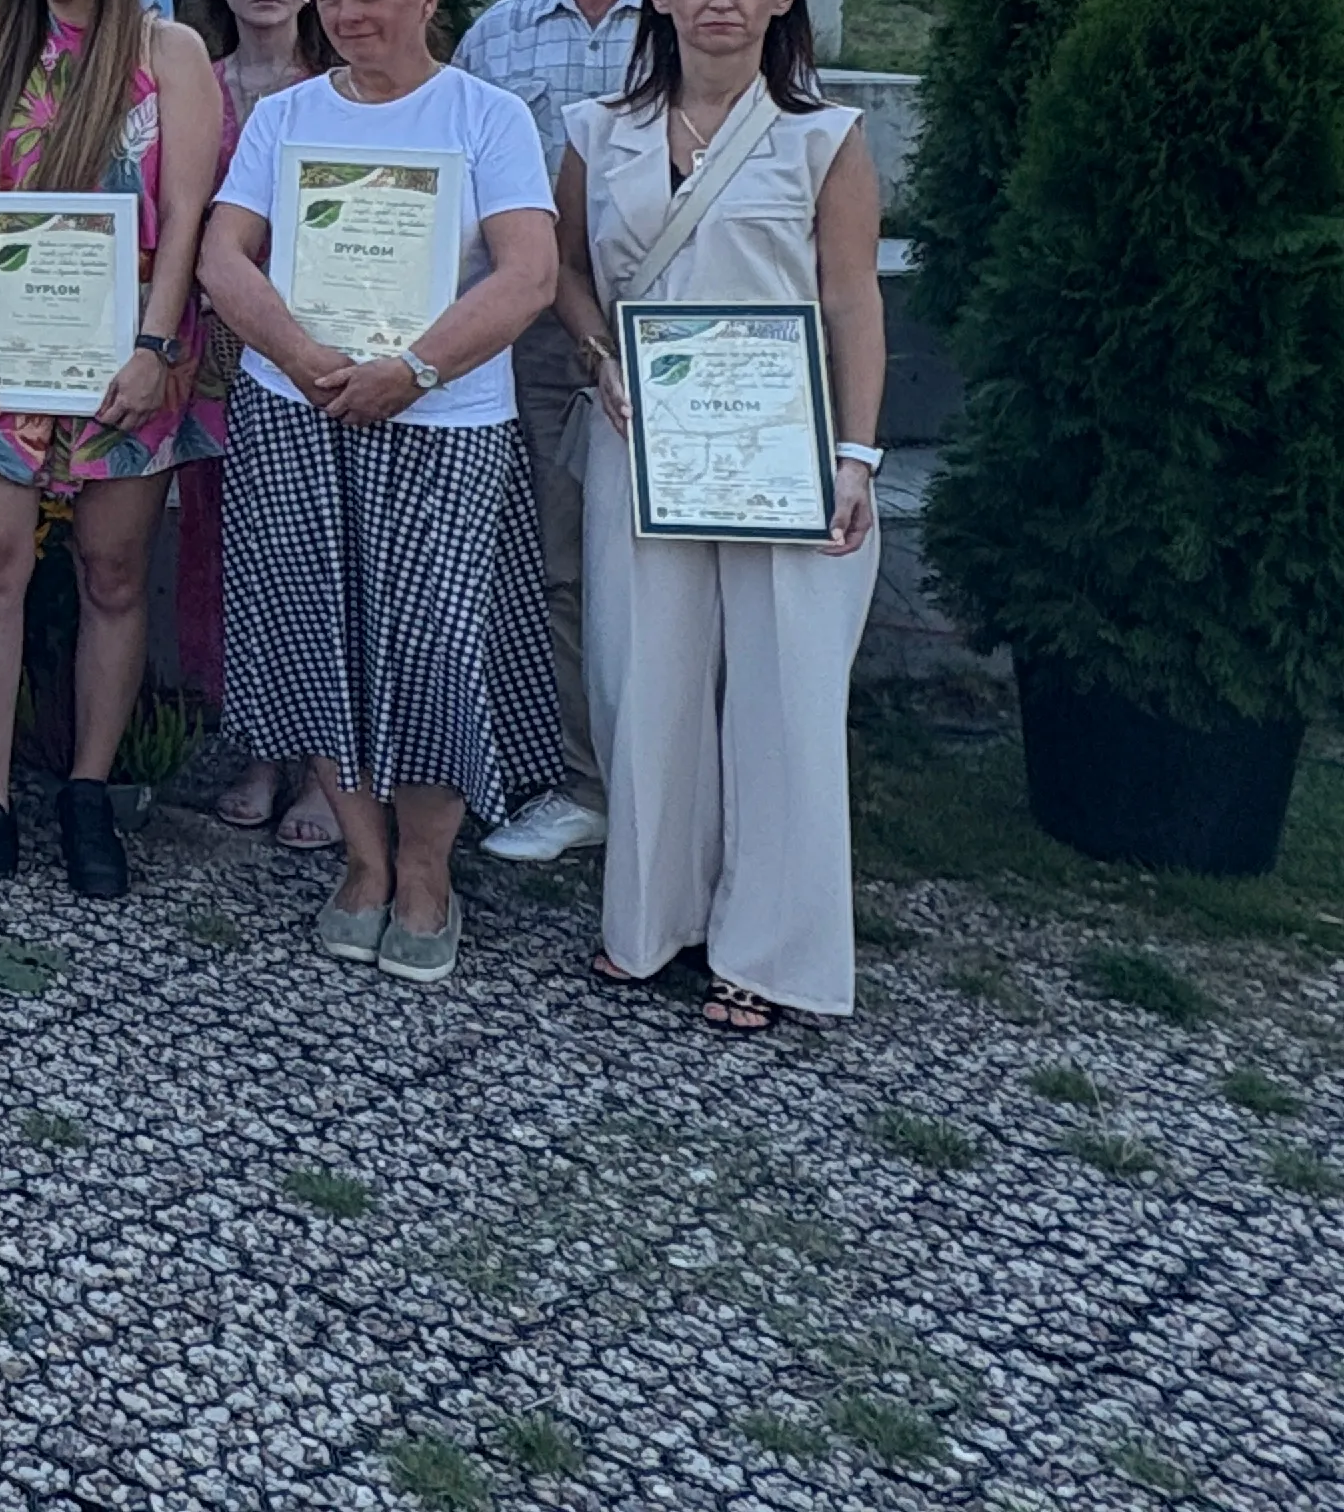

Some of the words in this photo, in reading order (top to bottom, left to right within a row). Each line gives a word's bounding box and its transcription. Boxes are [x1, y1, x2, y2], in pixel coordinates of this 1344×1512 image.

[334, 242, 394, 257] DYPLOM
[24, 282, 80, 296] DYPLOM
[690, 398, 761, 412] DYPLOM
